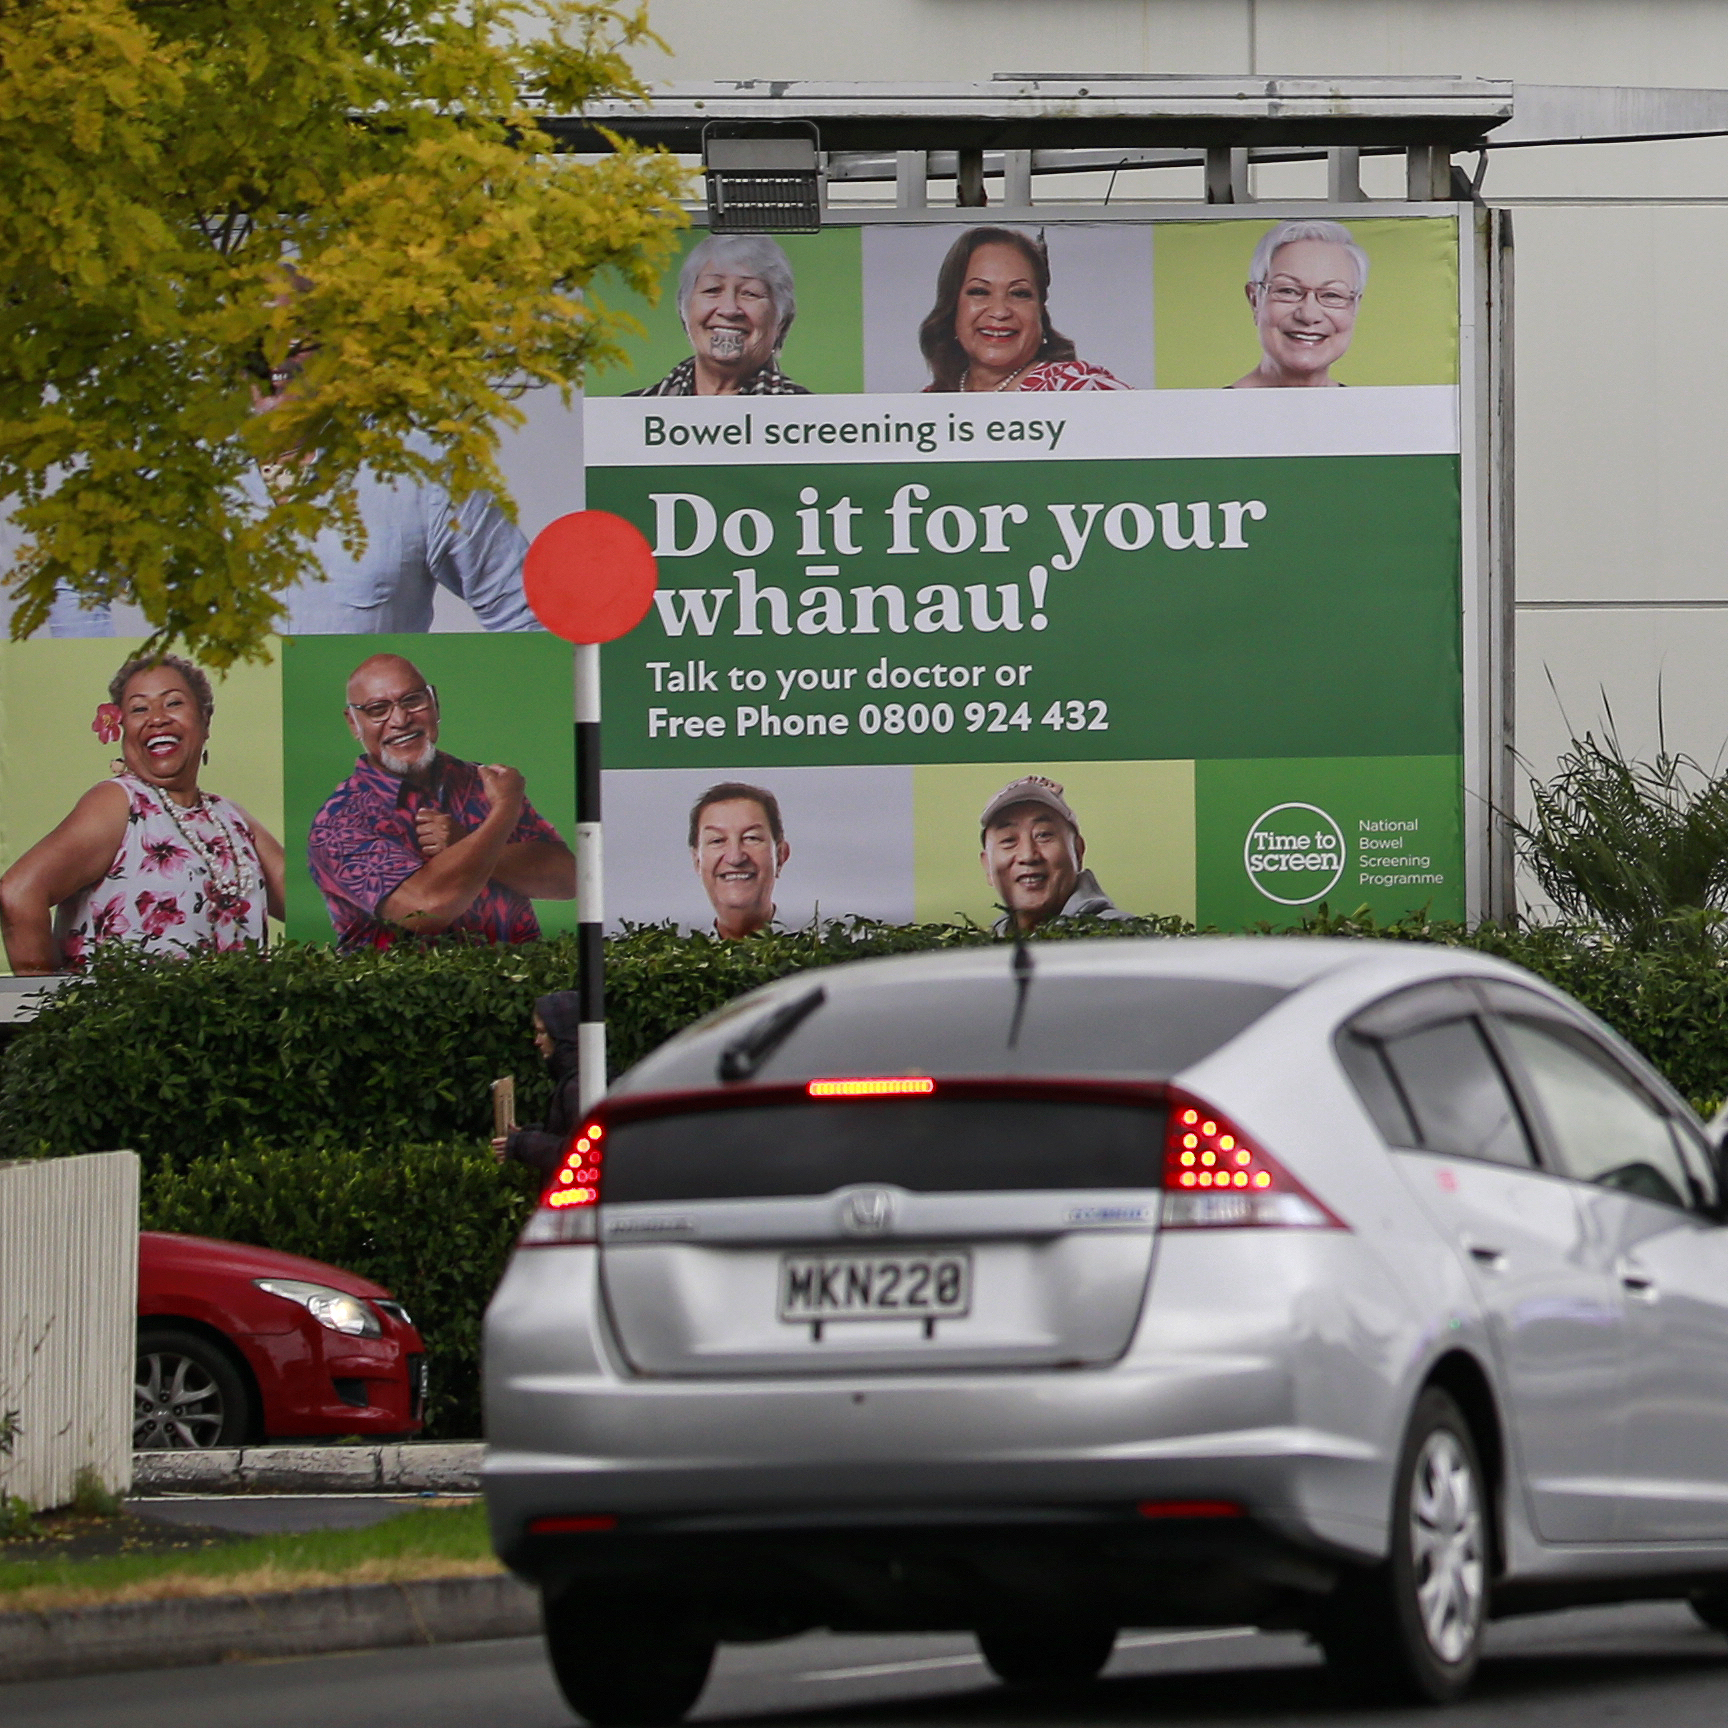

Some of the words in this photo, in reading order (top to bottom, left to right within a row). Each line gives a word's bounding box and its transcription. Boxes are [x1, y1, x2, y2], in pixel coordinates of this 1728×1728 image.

[644, 413, 752, 448] Bowel
[763, 412, 938, 454] screening
[947, 413, 976, 443] is
[985, 418, 1068, 451] easy
[649, 491, 774, 559] Do
[795, 485, 864, 558] it
[884, 482, 1028, 555] for
[1047, 495, 1268, 571] your
[653, 565, 1050, 639] whānau!
[646, 662, 719, 694] Talk
[727, 664, 767, 692] to
[775, 664, 858, 700] your
[866, 658, 986, 690] doctor
[995, 661, 1033, 687] or
[648, 706, 726, 739] Free
[737, 705, 849, 738] Phone
[859, 703, 954, 736] 0800
[964, 702, 1033, 735] 924
[1040, 699, 1109, 732] 432
[1359, 819, 1418, 832] National
[1253, 831, 1311, 851] Time
[1315, 831, 1337, 850] to
[1359, 836, 1403, 850] Bowel
[1249, 851, 1340, 872] screen
[1359, 854, 1430, 869] Screening
[1359, 872, 1444, 887] Programme
[786, 1261, 962, 1310] MKN220
